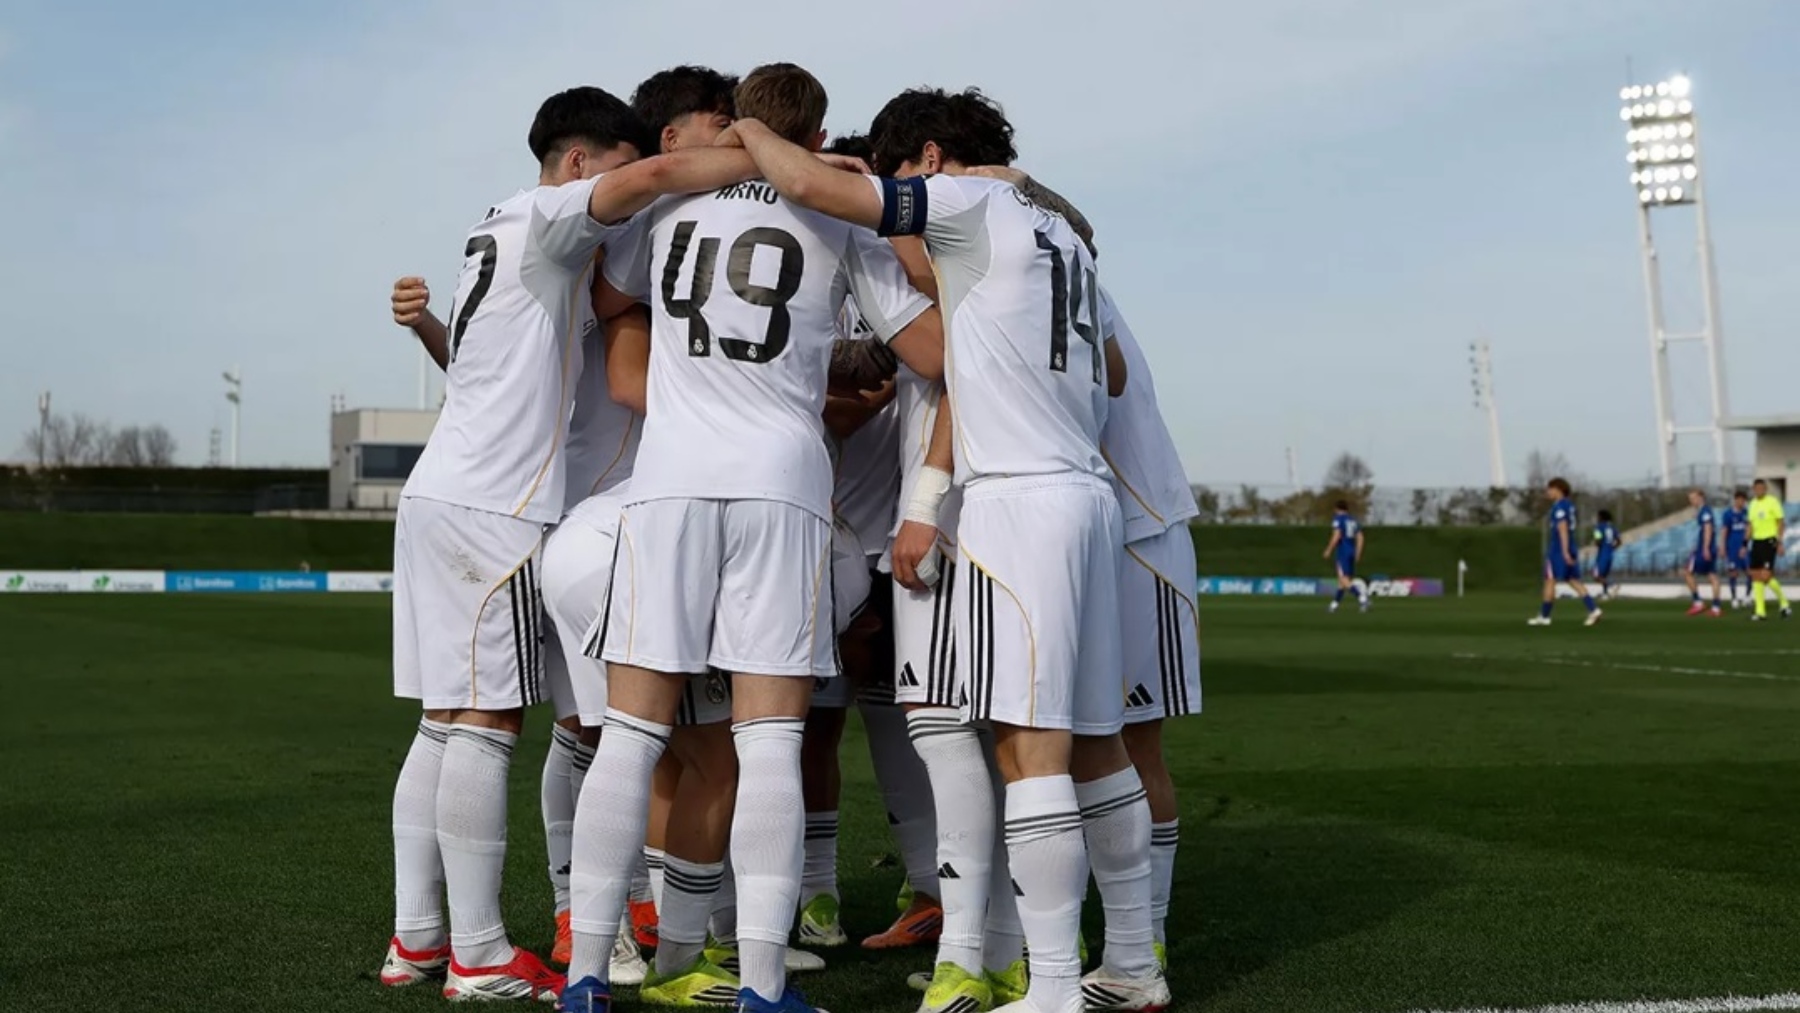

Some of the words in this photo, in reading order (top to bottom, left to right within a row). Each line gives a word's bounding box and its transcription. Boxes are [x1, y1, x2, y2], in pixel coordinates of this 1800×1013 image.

[448, 234, 497, 363] 7
[661, 221, 804, 363] 49
[1034, 228, 1102, 385] 14
